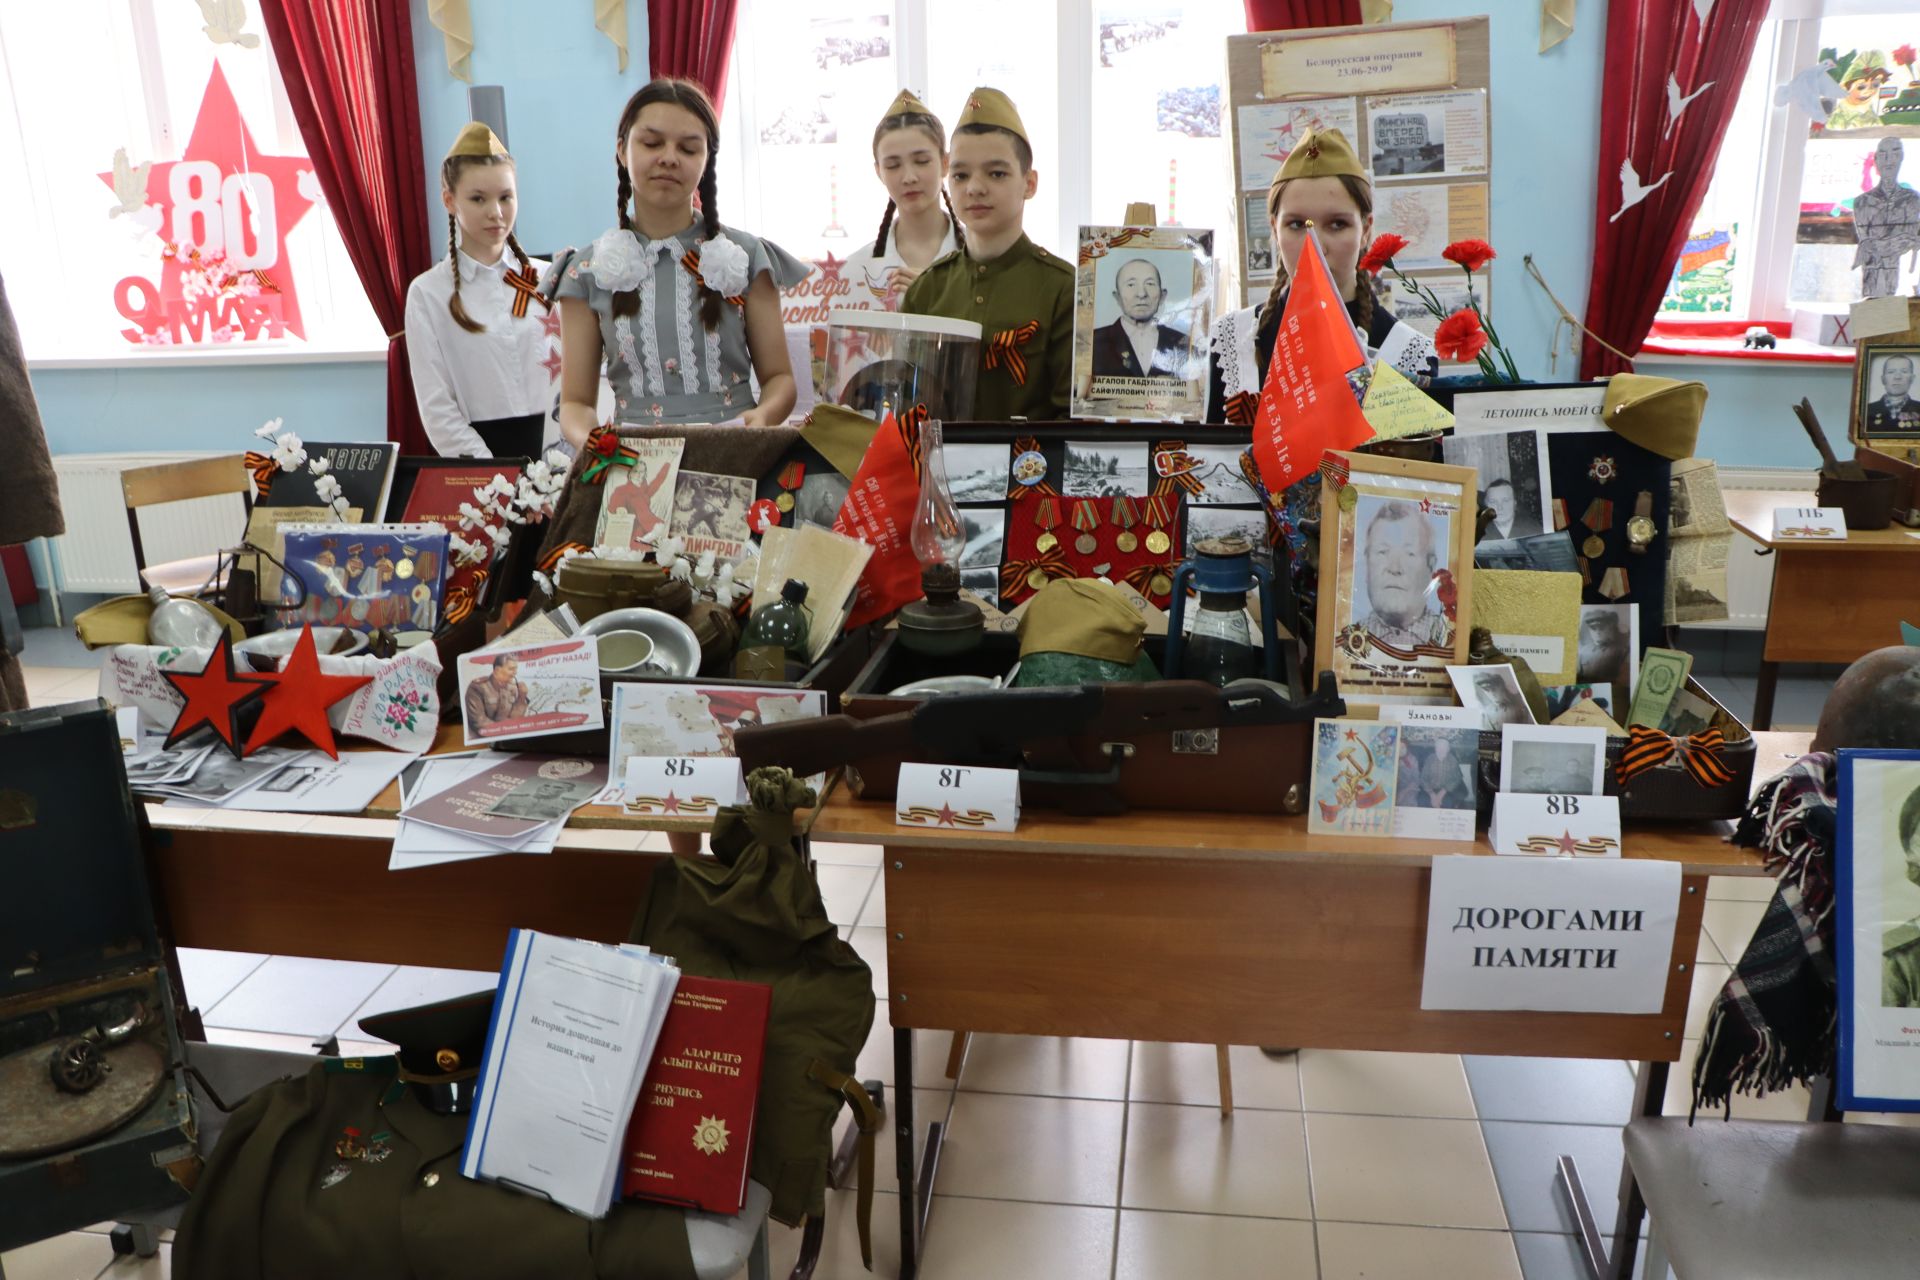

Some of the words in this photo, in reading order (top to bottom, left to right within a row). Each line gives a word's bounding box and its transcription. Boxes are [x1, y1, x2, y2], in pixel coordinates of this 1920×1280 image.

[1305, 55, 1371, 68] Белорусская
[1337, 64, 1393, 78] 23.06-29.09
[168, 159, 278, 272] 80
[780, 267, 851, 307] обеда
[103, 276, 166, 344] 9
[165, 294, 286, 345] МАЯ
[1286, 314, 1300, 335] 150
[1480, 407, 1549, 419] ЛЕТОПИСЬ
[1550, 403, 1589, 418] МОЕЙ
[681, 536, 743, 557] ЛИНГРАД
[538, 658, 561, 668] ШАГУ
[562, 652, 592, 663] НАЗАД!
[663, 757, 696, 778] 8Б
[938, 767, 971, 789] 8Г
[1545, 794, 1580, 816] 8В
[1452, 906, 1646, 934] ДОРОГАМИ
[1471, 946, 1619, 970] ПАМЯТИ
[530, 1014, 567, 1034] История
[566, 1028, 611, 1050] дошедшая
[610, 1043, 623, 1054] до
[545, 1040, 574, 1057] наших
[573, 1051, 596, 1065] дней
[682, 1047, 711, 1059] АЛАР
[660, 1056, 693, 1069] АЛЫП
[694, 1060, 741, 1078] КАЙТТЫ
[653, 1082, 704, 1100] РНУЛИСЬ
